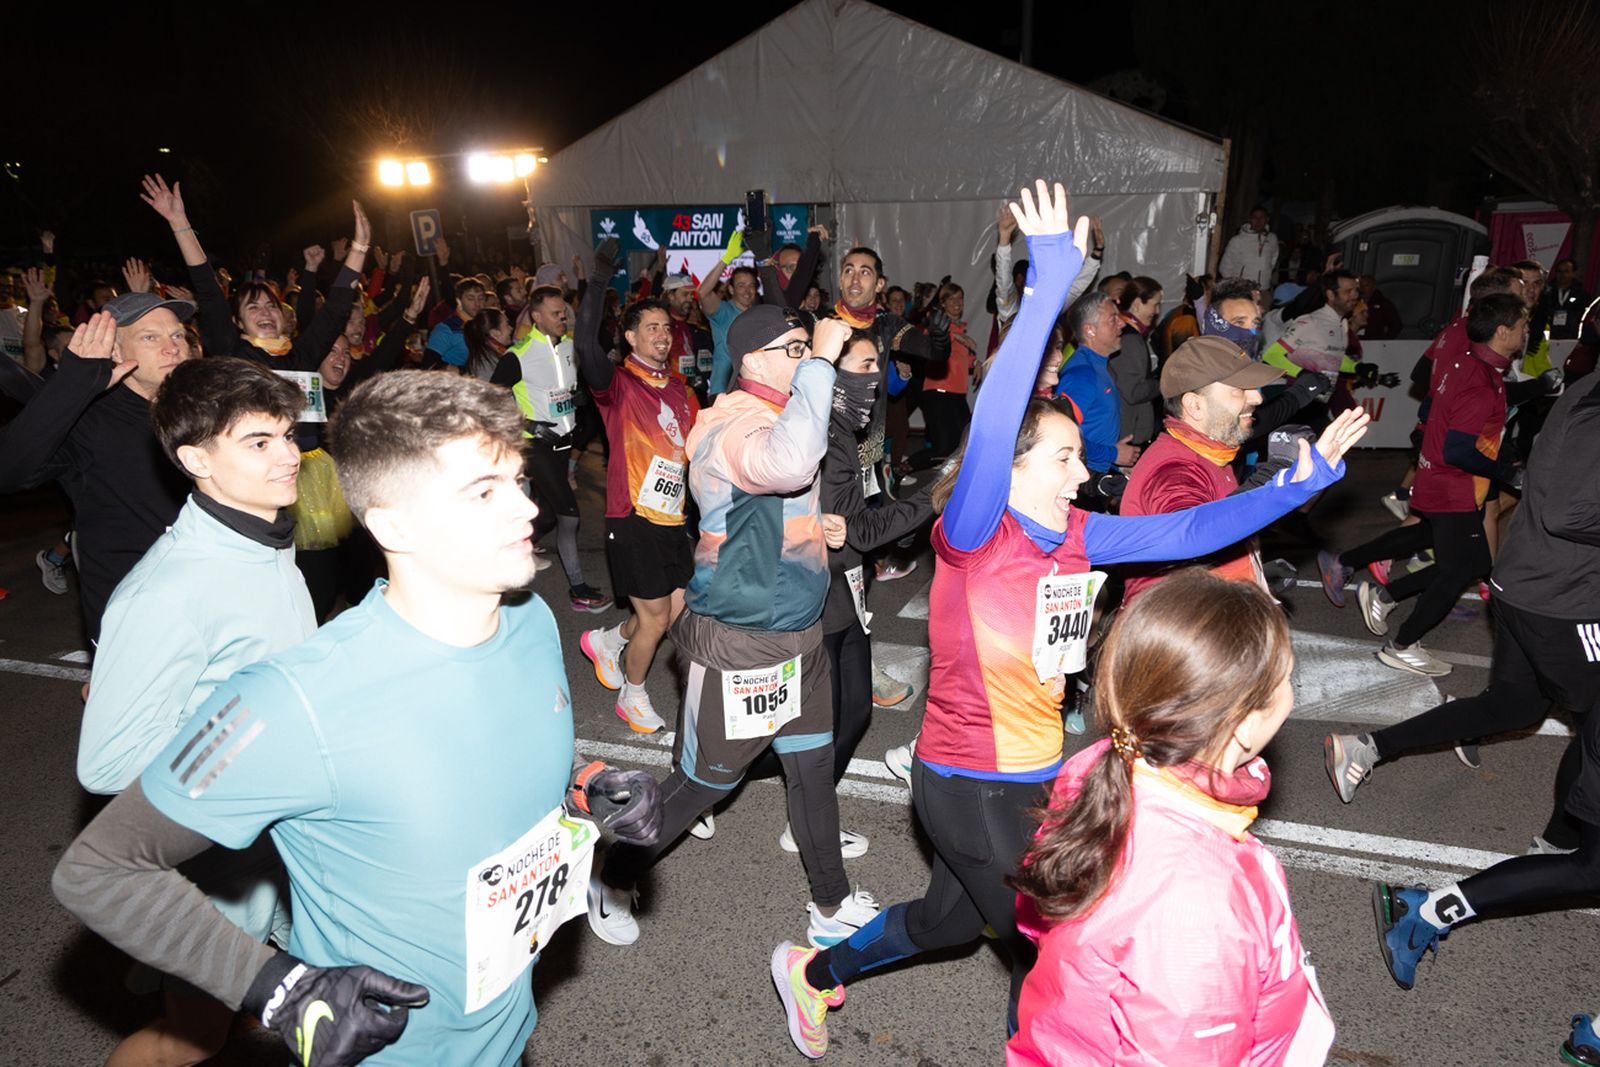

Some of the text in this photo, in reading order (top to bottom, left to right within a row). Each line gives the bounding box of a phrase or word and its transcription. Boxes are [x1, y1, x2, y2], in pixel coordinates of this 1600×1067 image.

[418, 215, 436, 239] P
[672, 213, 724, 231] 43 SAN
[669, 227, 722, 247] ANTÓN
[1053, 586, 1082, 599] NOCHE DE
[1045, 602, 1059, 614] SAN
[1047, 610, 1088, 645] 3440
[733, 686, 751, 695] SAN
[743, 677, 769, 685] NOCHE
[742, 683, 788, 716] 1055
[506, 831, 561, 880] NOCHE DE
[487, 880, 518, 908] SAN
[513, 862, 570, 936] 278
